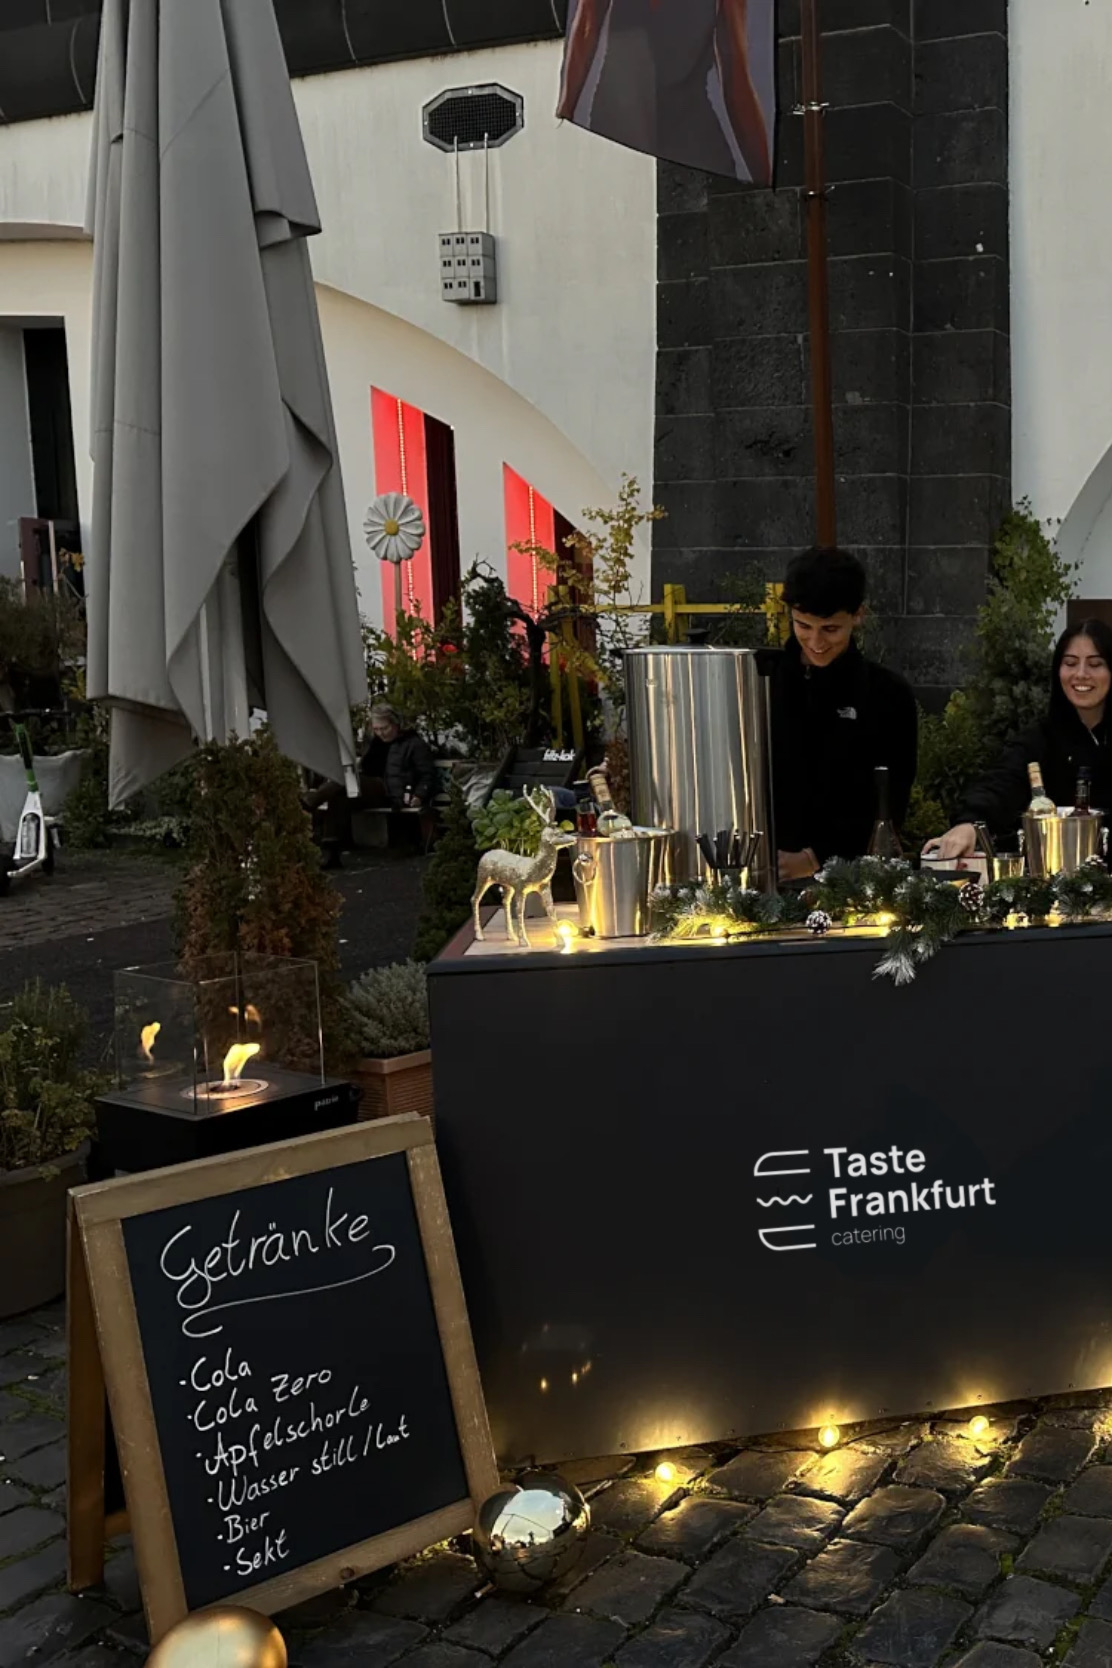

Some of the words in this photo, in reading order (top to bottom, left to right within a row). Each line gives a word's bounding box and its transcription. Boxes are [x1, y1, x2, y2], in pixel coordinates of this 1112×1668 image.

[823, 1146, 926, 1178] Taste
[829, 1178, 996, 1219] Frankfurt
[160, 1186, 371, 1309] Getränke
[831, 1225, 906, 1246] catering
[190, 1347, 253, 1392] Cola
[193, 1387, 259, 1432] Cola
[270, 1368, 333, 1403] Zero
[204, 1385, 371, 1478] Apfelschorle
[217, 1464, 300, 1512] Wasser
[223, 1511, 271, 1544] Bier
[235, 1528, 290, 1576] Sekt
